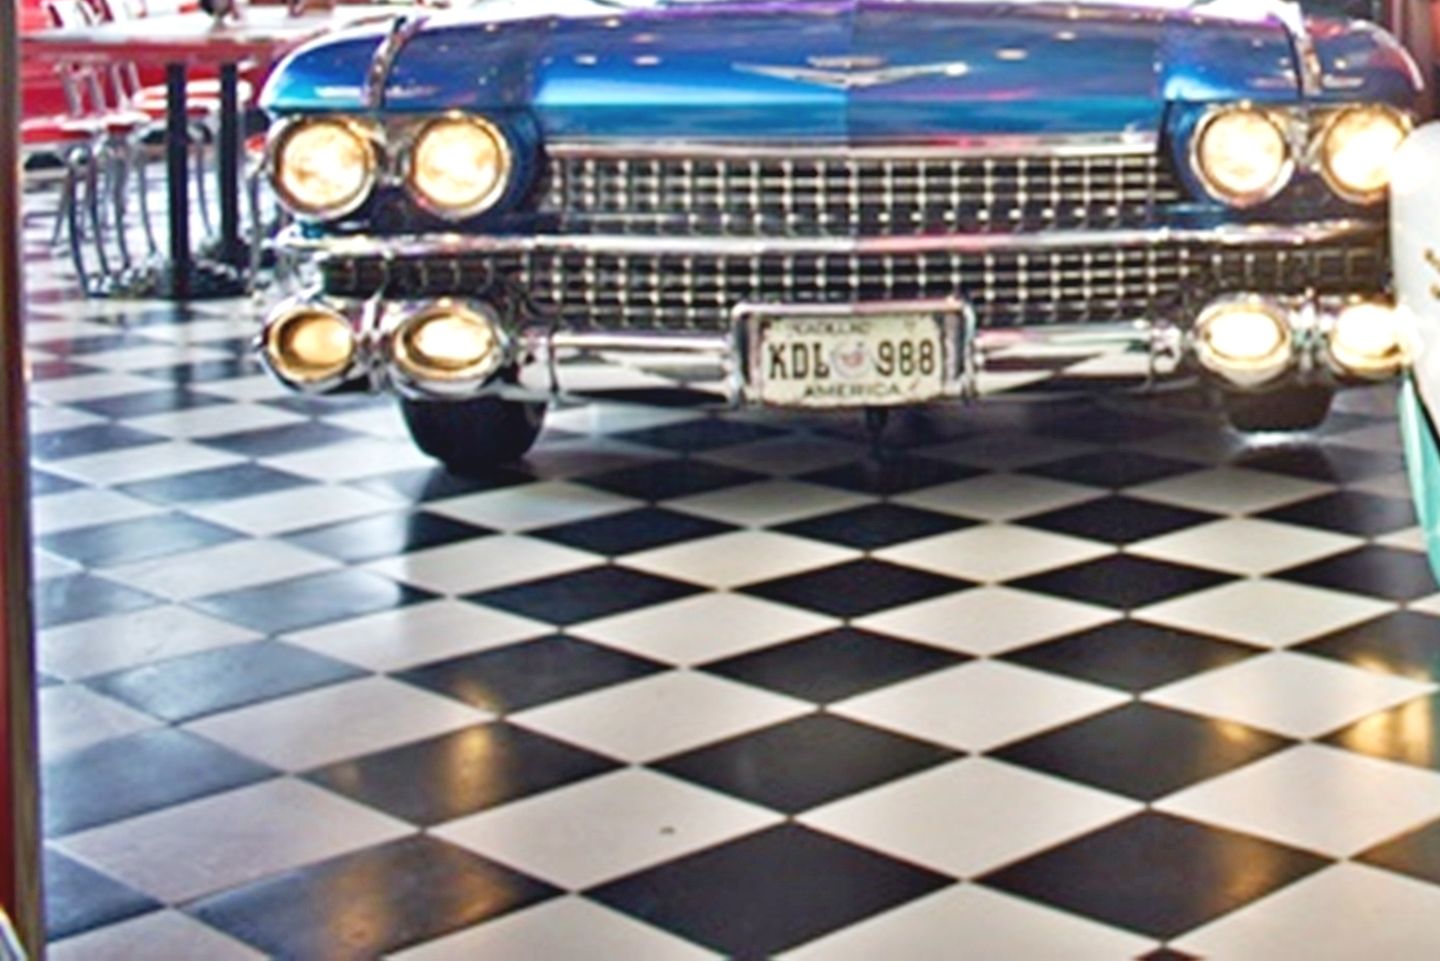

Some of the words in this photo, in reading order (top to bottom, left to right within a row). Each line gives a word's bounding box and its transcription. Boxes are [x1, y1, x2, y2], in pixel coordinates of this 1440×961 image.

[768, 341, 830, 380] KDL
[876, 339, 935, 377] 988
[804, 383, 901, 398] AMERICA
